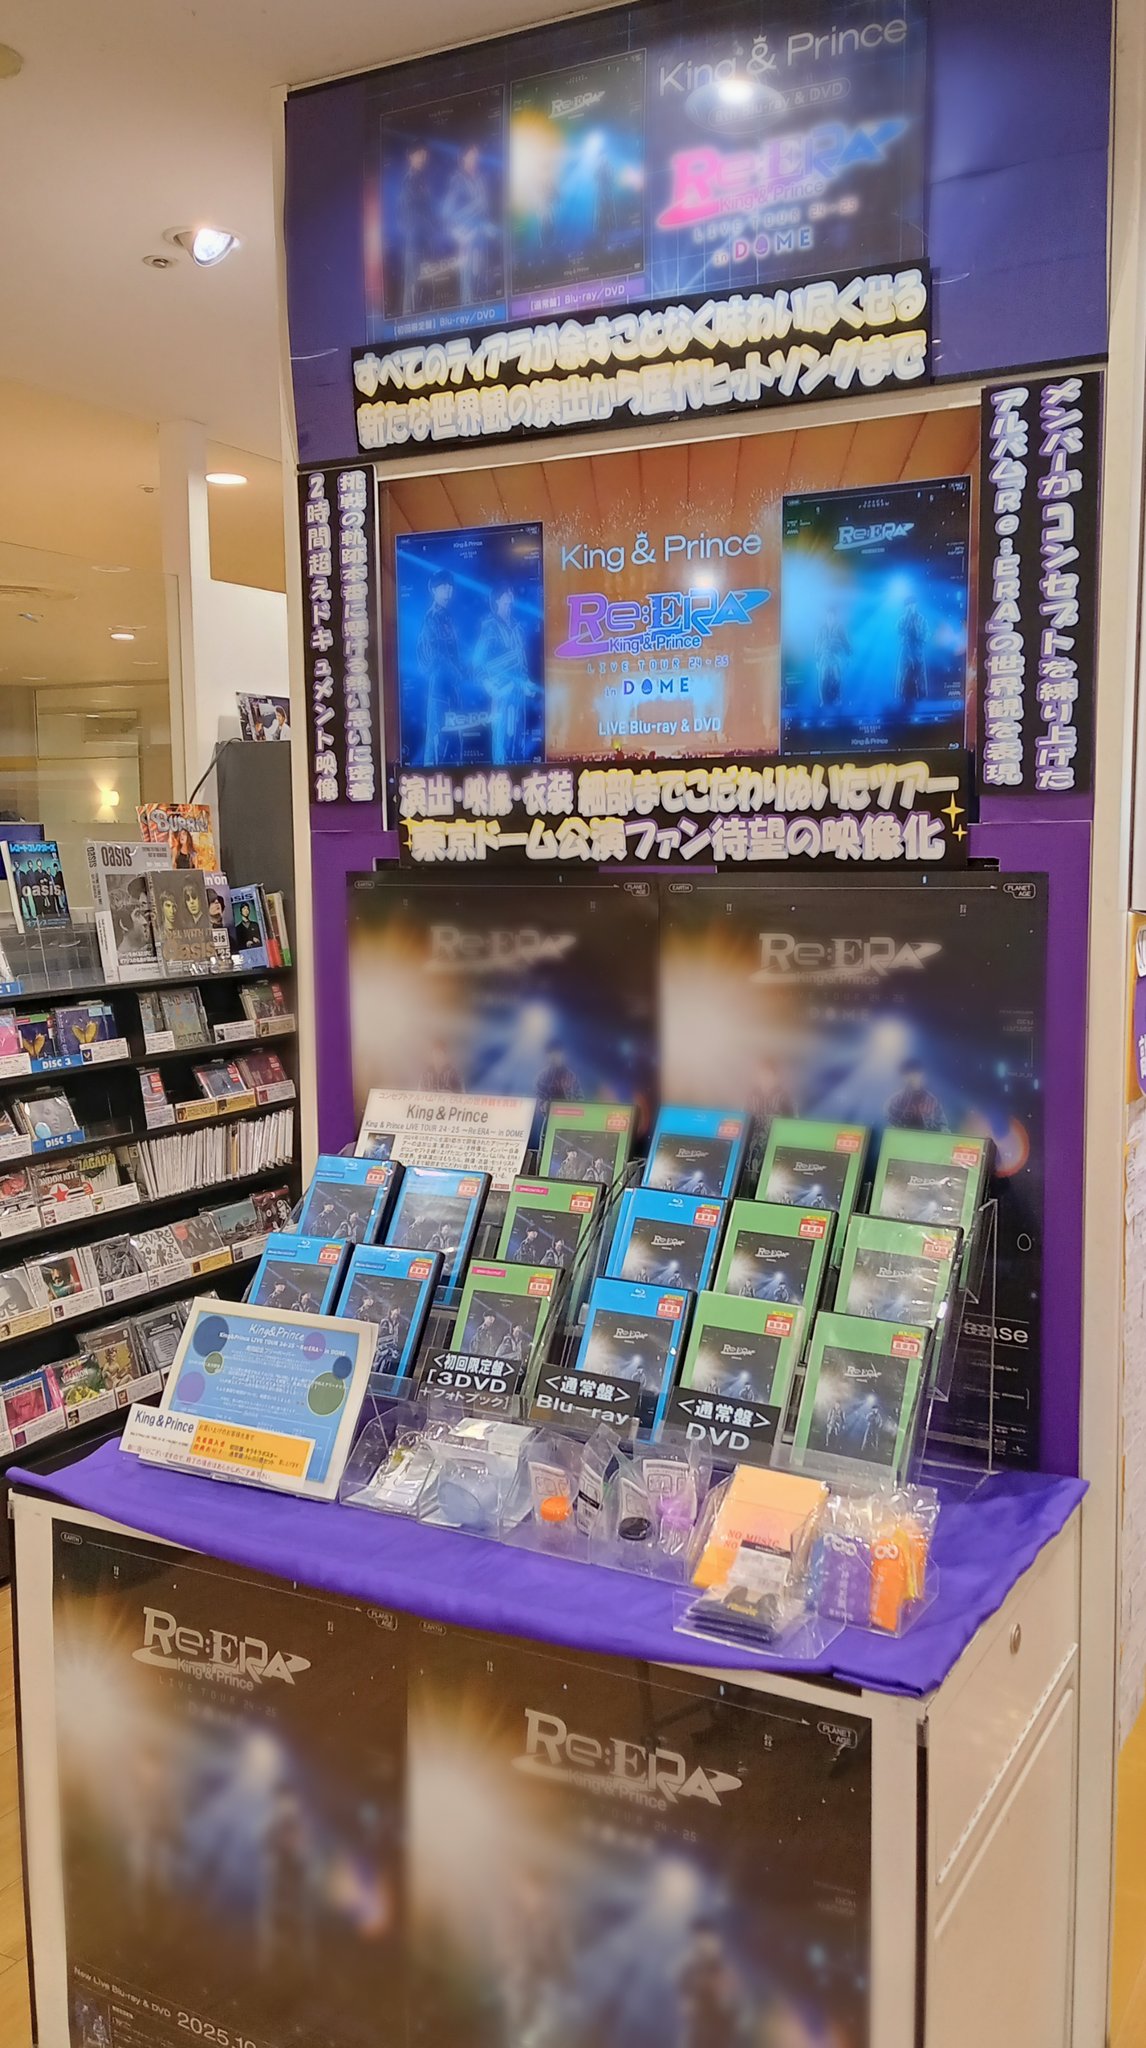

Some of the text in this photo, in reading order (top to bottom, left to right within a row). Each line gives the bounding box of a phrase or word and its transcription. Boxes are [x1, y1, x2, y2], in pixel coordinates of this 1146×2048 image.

[660, 54, 737, 96] King
[787, 19, 908, 67] Prince
[809, 82, 843, 102] DVD
[561, 544, 625, 573] King
[631, 532, 657, 565] &
[664, 533, 762, 562] Prince
[560, 587, 767, 648] Re:ERA
[609, 633, 702, 655] King & Prince
[587, 659, 630, 675] LIVE
[638, 657, 681, 672] TOUR
[598, 716, 721, 737] LIVE Blu-ray & DVD
[399, 769, 574, 818] 演出・映像・衣装
[411, 811, 946, 863] 東京ドーム公演ファン待望の映像化
[21, 883, 62, 897] oasis
[1007, 884, 1032, 892] PLANET
[1018, 890, 1032, 898] AGE
[755, 933, 937, 978] Re:ERA
[42, 1058, 72, 1070] DISC 3
[406, 1104, 489, 1123] King & Prince
[405, 1123, 418, 1131] LIVE
[420, 1124, 438, 1132] TOUR
[505, 1130, 525, 1138] DOME
[45, 1138, 65, 1149] DISC
[134, 1410, 195, 1434] King & Prince
[685, 1424, 750, 1451] DVD
[138, 1606, 303, 1686] Re:ERA
[177, 1657, 254, 1692] King & Prince
[822, 1724, 852, 1738] PLANET
[834, 1735, 852, 1745] AGE
[518, 1708, 733, 1806] Re:ERA
[568, 1768, 603, 1793] King
[617, 1783, 668, 1812] Prince
[74, 1966, 92, 1982] New
[93, 1975, 111, 1992] Live
[111, 1985, 142, 2006] Blu-ray
[151, 2002, 172, 2018] DVD
